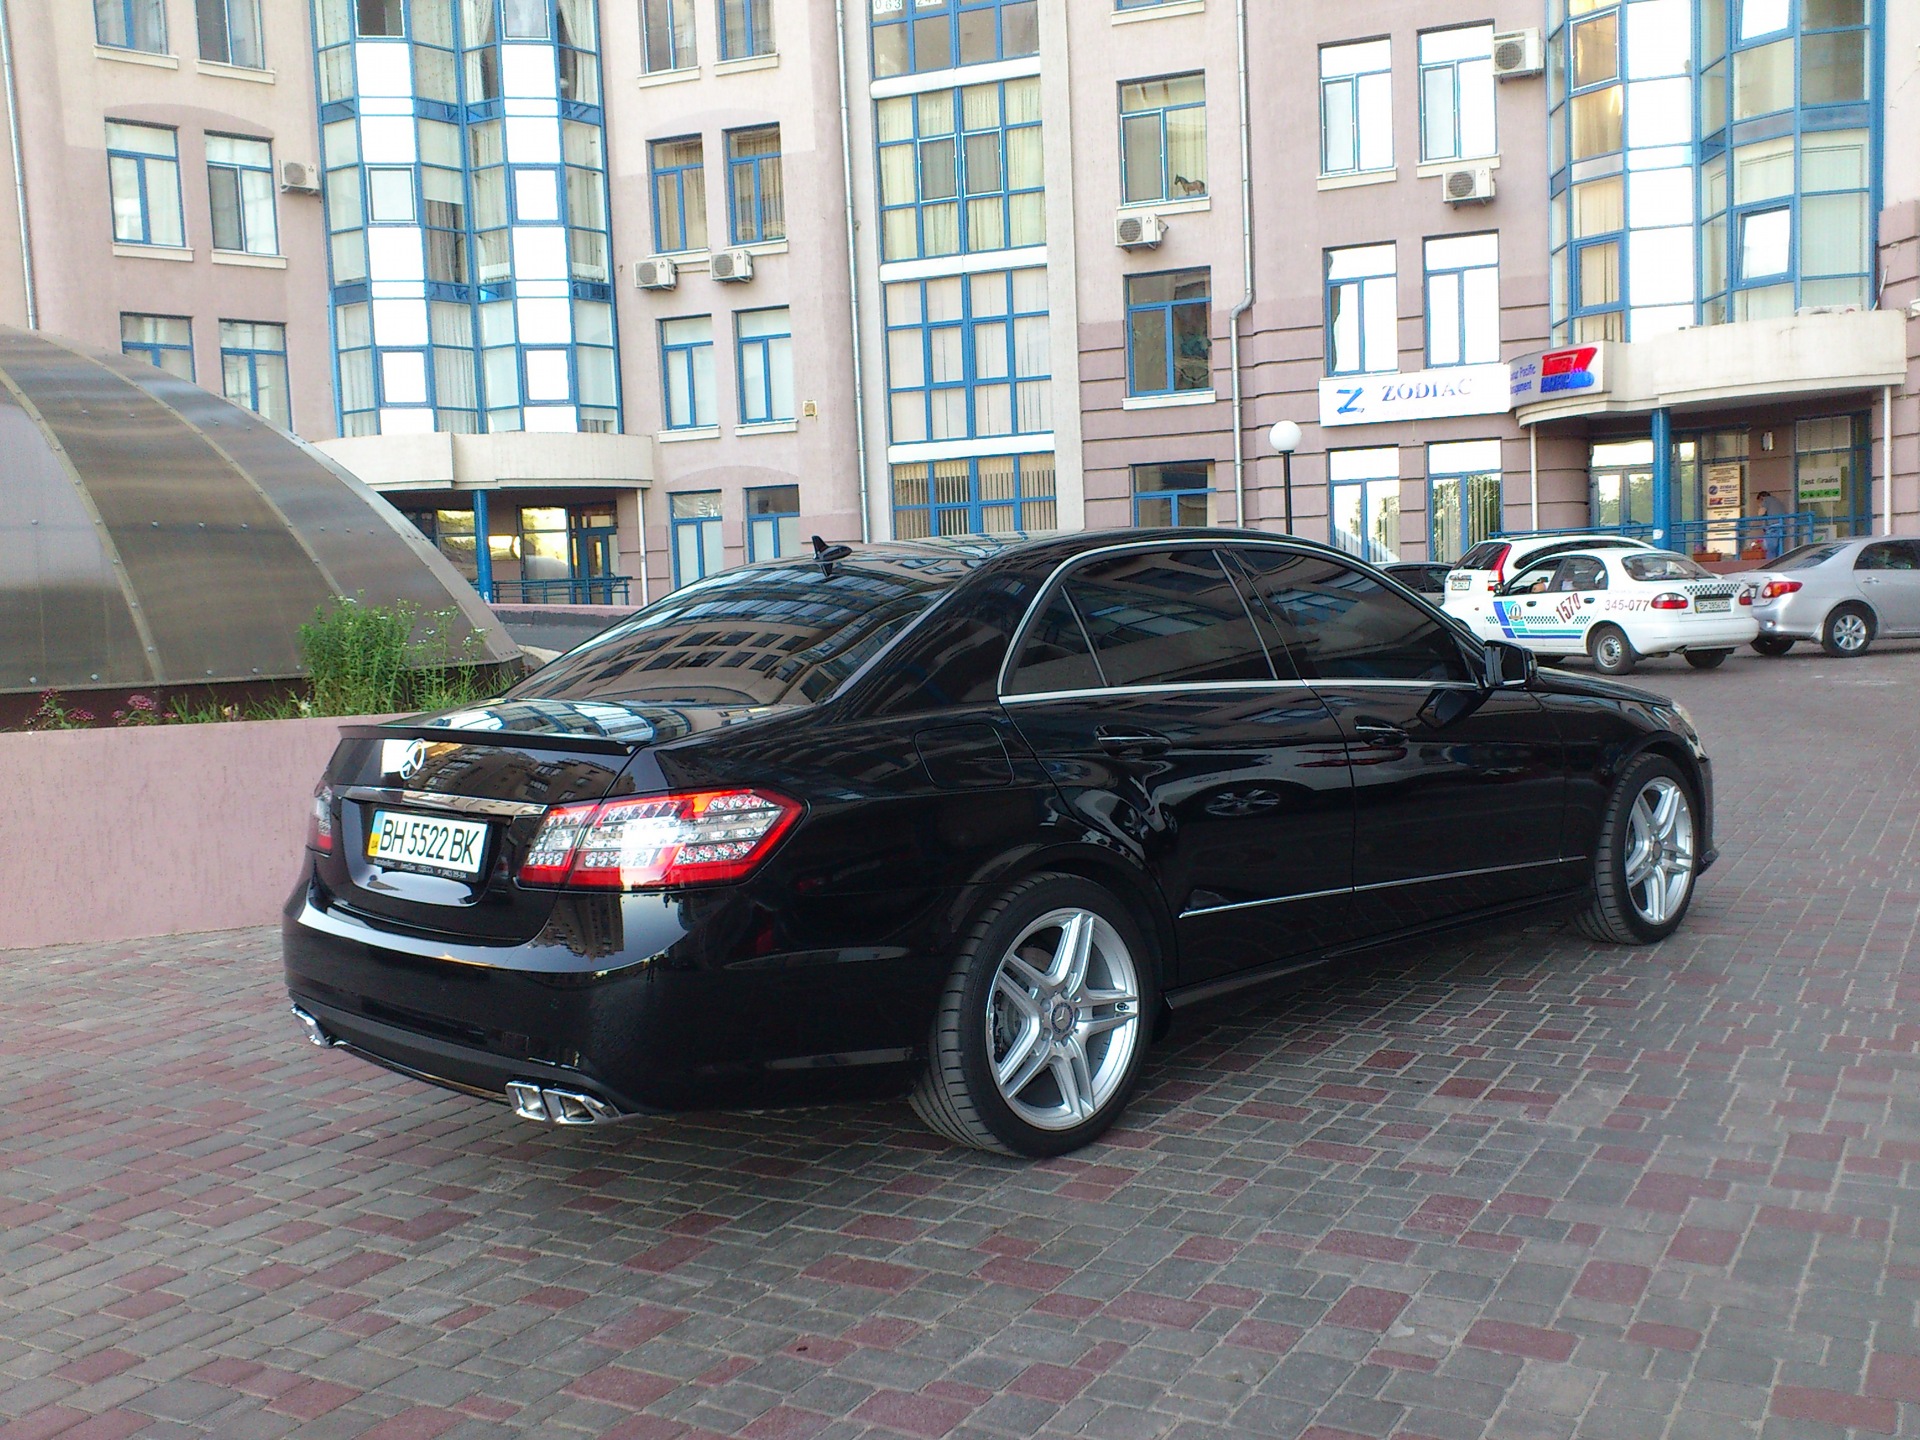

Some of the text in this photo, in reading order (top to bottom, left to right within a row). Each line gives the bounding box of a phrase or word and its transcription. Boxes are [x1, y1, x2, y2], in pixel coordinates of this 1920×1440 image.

[1381, 378, 1473, 402] ZODIAC
[1556, 593, 1581, 623] 1570
[1605, 600, 1650, 612] 345-077
[380, 819, 480, 865] BH 5522 BK
